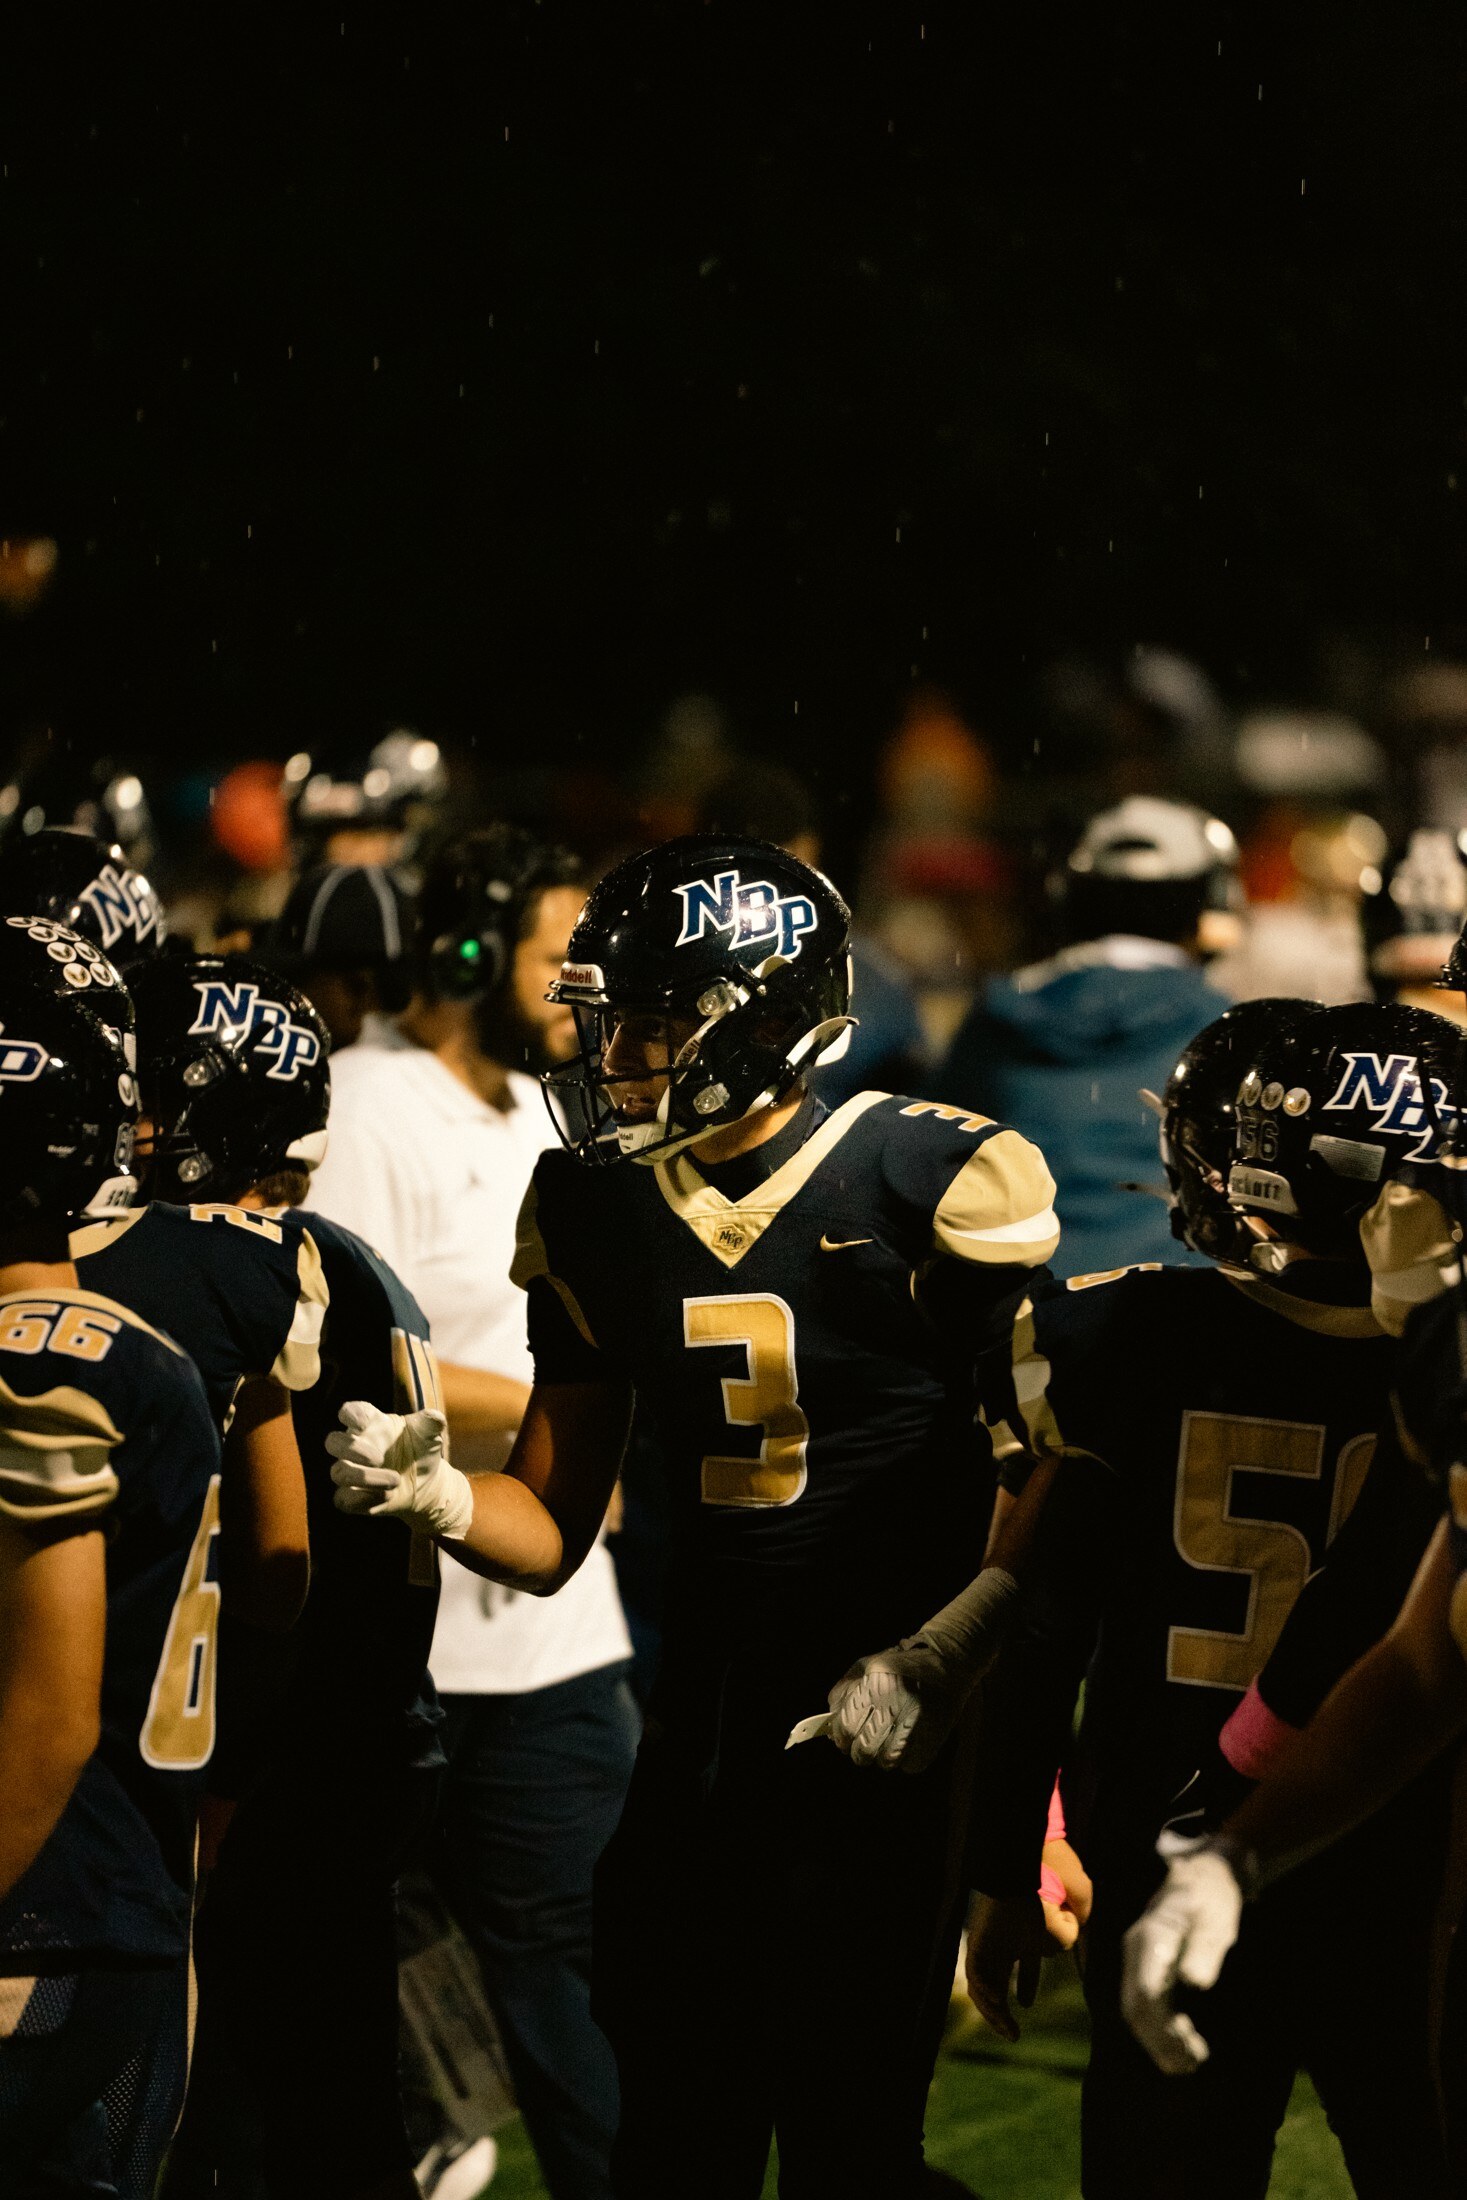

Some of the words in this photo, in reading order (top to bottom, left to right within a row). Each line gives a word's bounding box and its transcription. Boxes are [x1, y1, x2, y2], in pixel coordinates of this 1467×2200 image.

[671, 870, 818, 959] NBP
[187, 981, 320, 1081] NBP
[0, 1302, 122, 1362] 66
[683, 1292, 810, 1509] 3
[1166, 1409, 1378, 1692] 5
